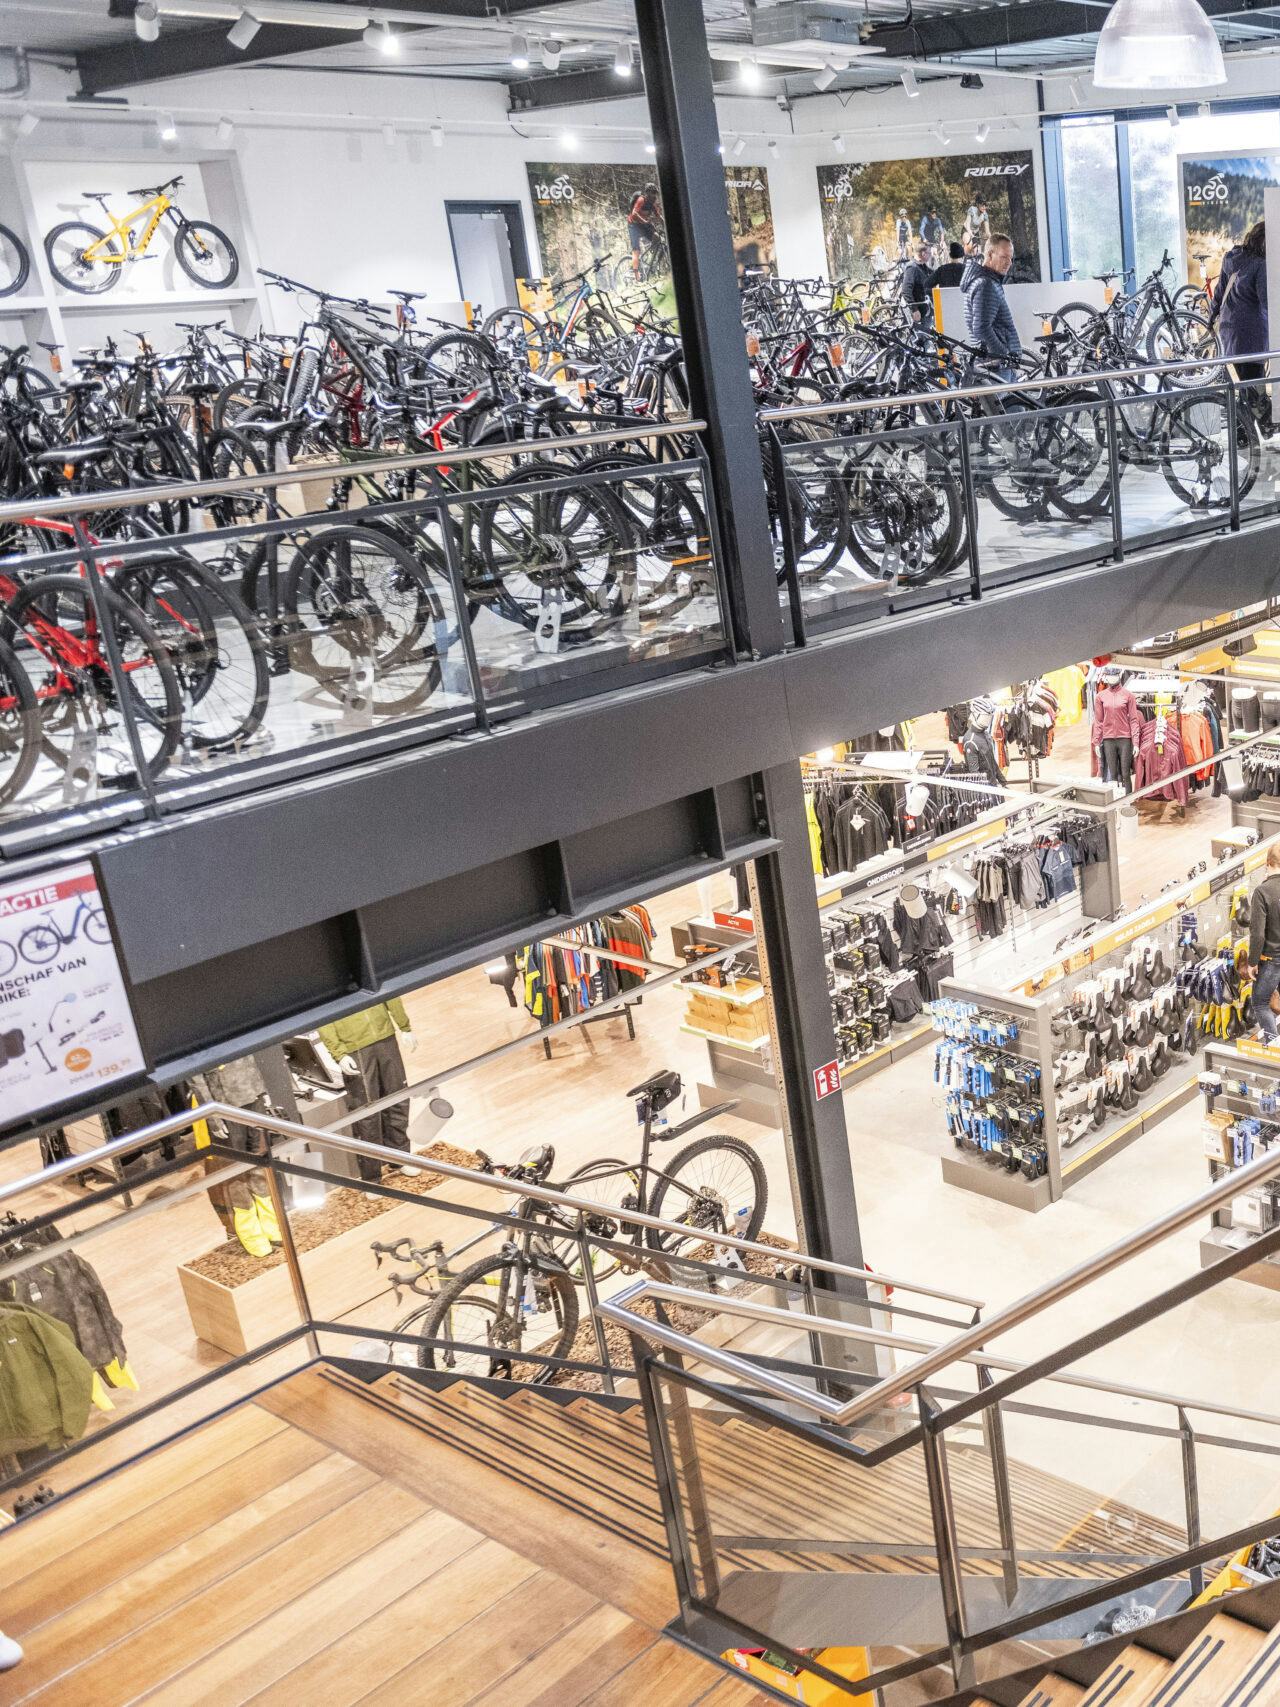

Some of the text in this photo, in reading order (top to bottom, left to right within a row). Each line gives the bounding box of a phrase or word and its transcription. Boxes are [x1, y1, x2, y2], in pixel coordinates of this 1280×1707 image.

[963, 164, 1030, 178] RIDLEY
[534, 184, 575, 200] 12GO
[1187, 184, 1229, 201] 12GO
[866, 867, 904, 887] ONDERGOED
[0, 886, 59, 916] ACTIE
[57, 957, 87, 974] VAN
